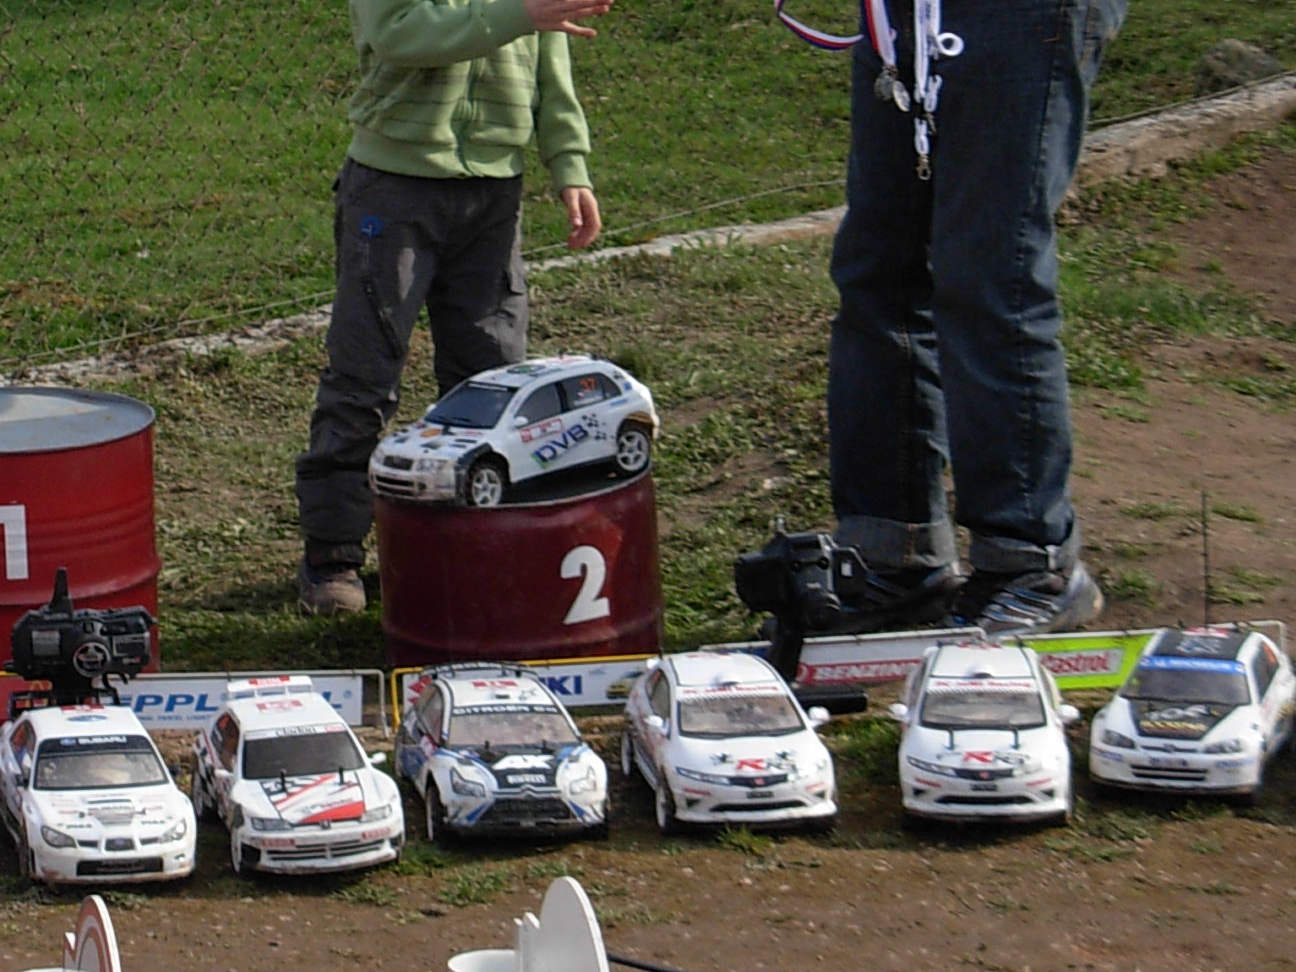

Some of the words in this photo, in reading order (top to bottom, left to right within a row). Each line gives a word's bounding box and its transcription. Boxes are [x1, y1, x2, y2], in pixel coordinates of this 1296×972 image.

[533, 423, 590, 463] DVB
[560, 544, 611, 626] 2
[78, 735, 128, 745] SUBARU
